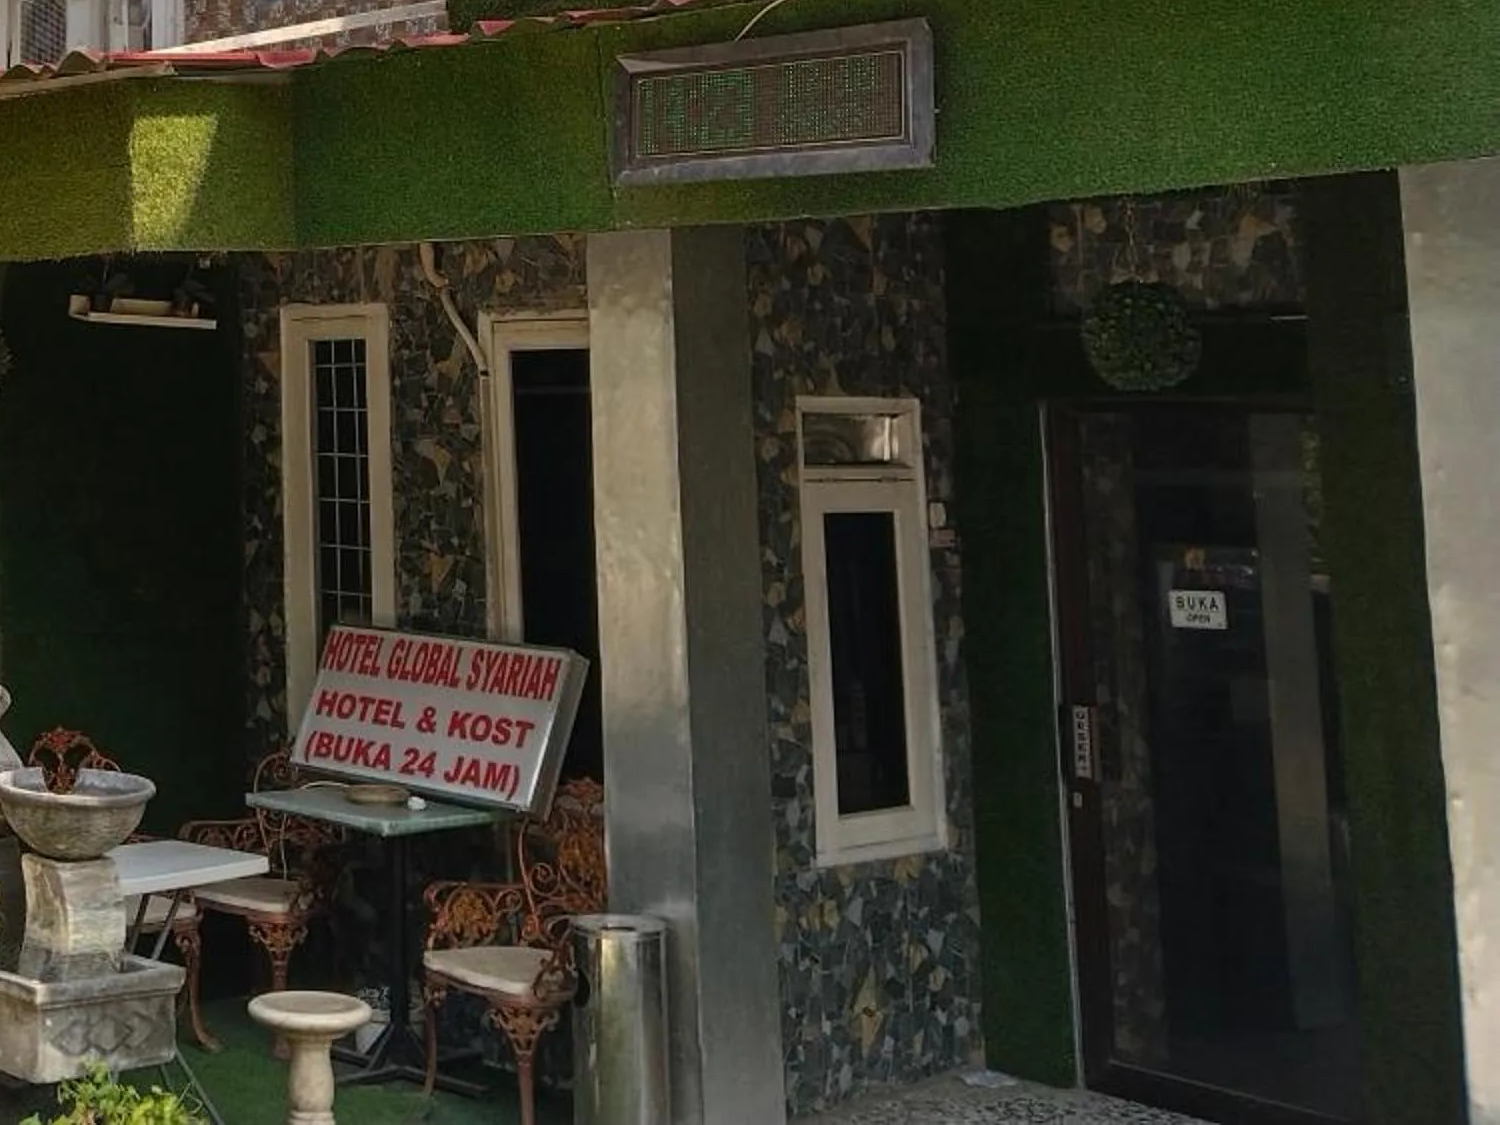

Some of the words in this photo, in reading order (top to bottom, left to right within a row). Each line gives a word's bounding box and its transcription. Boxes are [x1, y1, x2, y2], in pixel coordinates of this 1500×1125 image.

[1176, 596, 1219, 611] BUKA
[1186, 613, 1211, 624] OPEN
[322, 630, 385, 679] HOTEL
[387, 637, 464, 688] GLOBAL
[466, 649, 562, 702] SYARIAH
[315, 690, 406, 730] HOTEL
[415, 706, 437, 734] &
[447, 711, 536, 749] KOST
[304, 730, 392, 772] (BUKA
[398, 747, 438, 778] 24
[443, 756, 521, 801] JAM)
